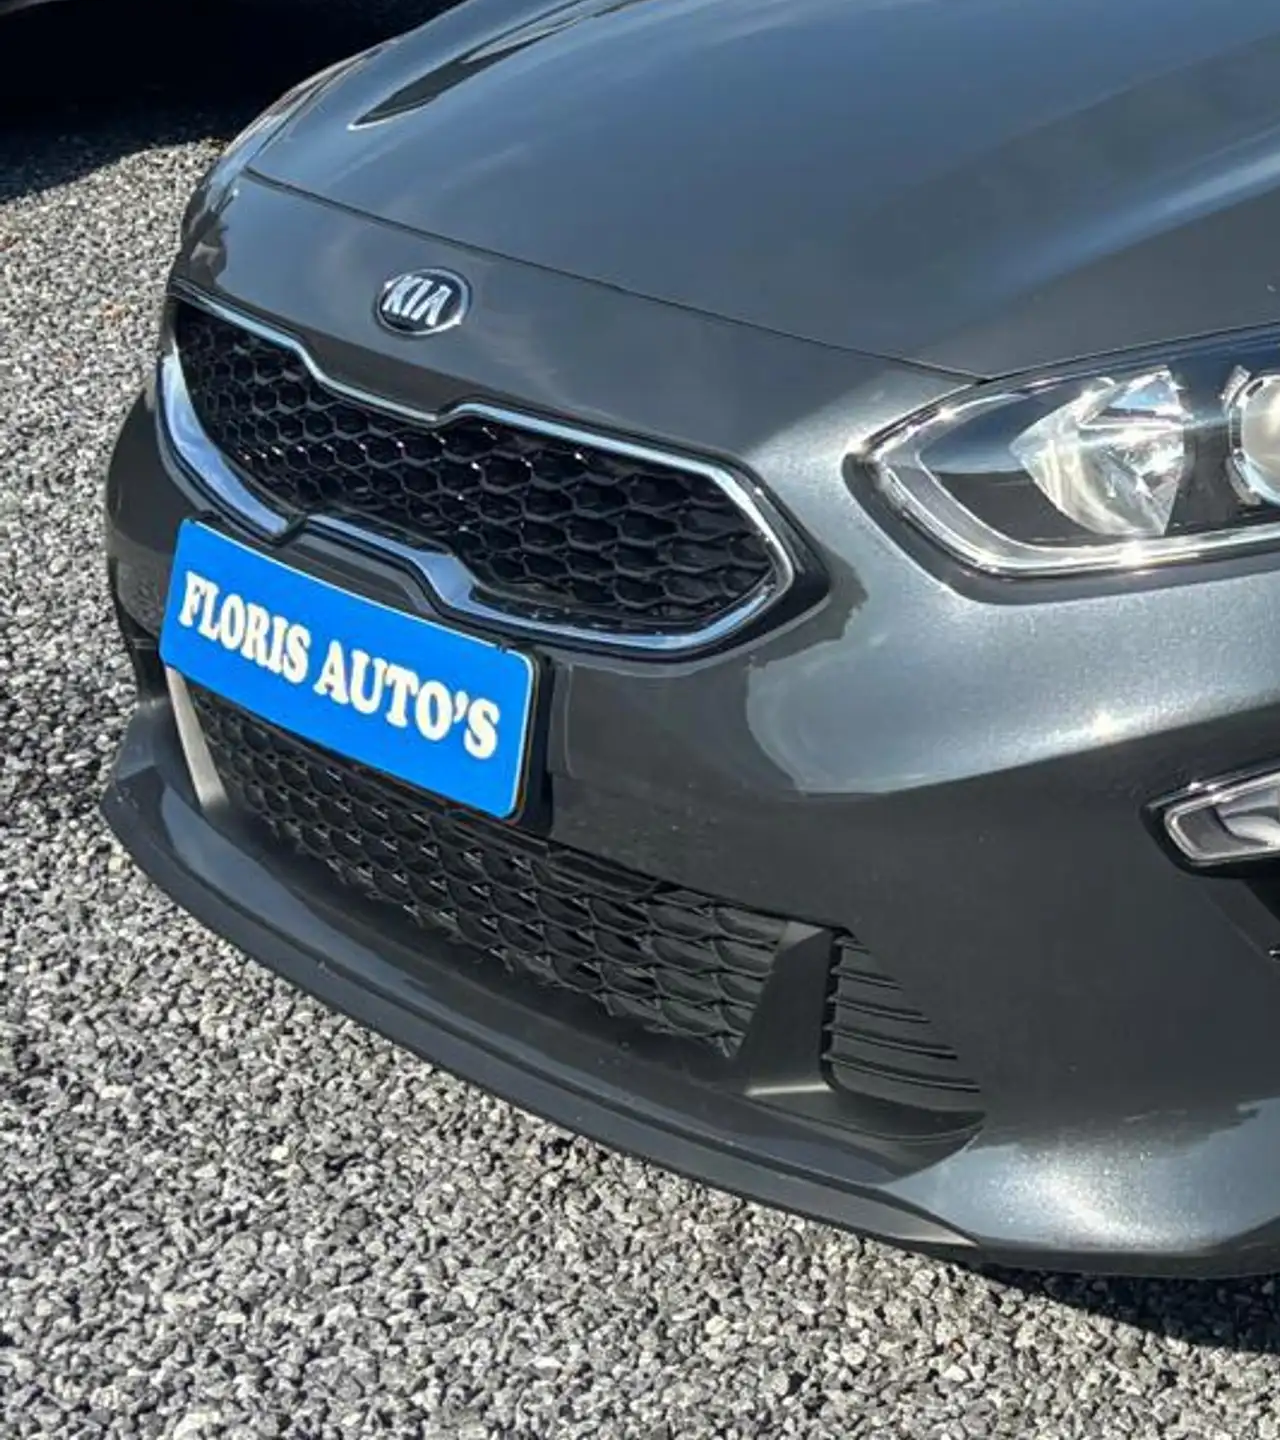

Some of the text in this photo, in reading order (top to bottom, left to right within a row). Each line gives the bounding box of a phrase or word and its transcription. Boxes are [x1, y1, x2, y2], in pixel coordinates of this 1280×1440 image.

[380, 274, 453, 328] KIA
[178, 569, 502, 761] FLORIS AUTO'S
